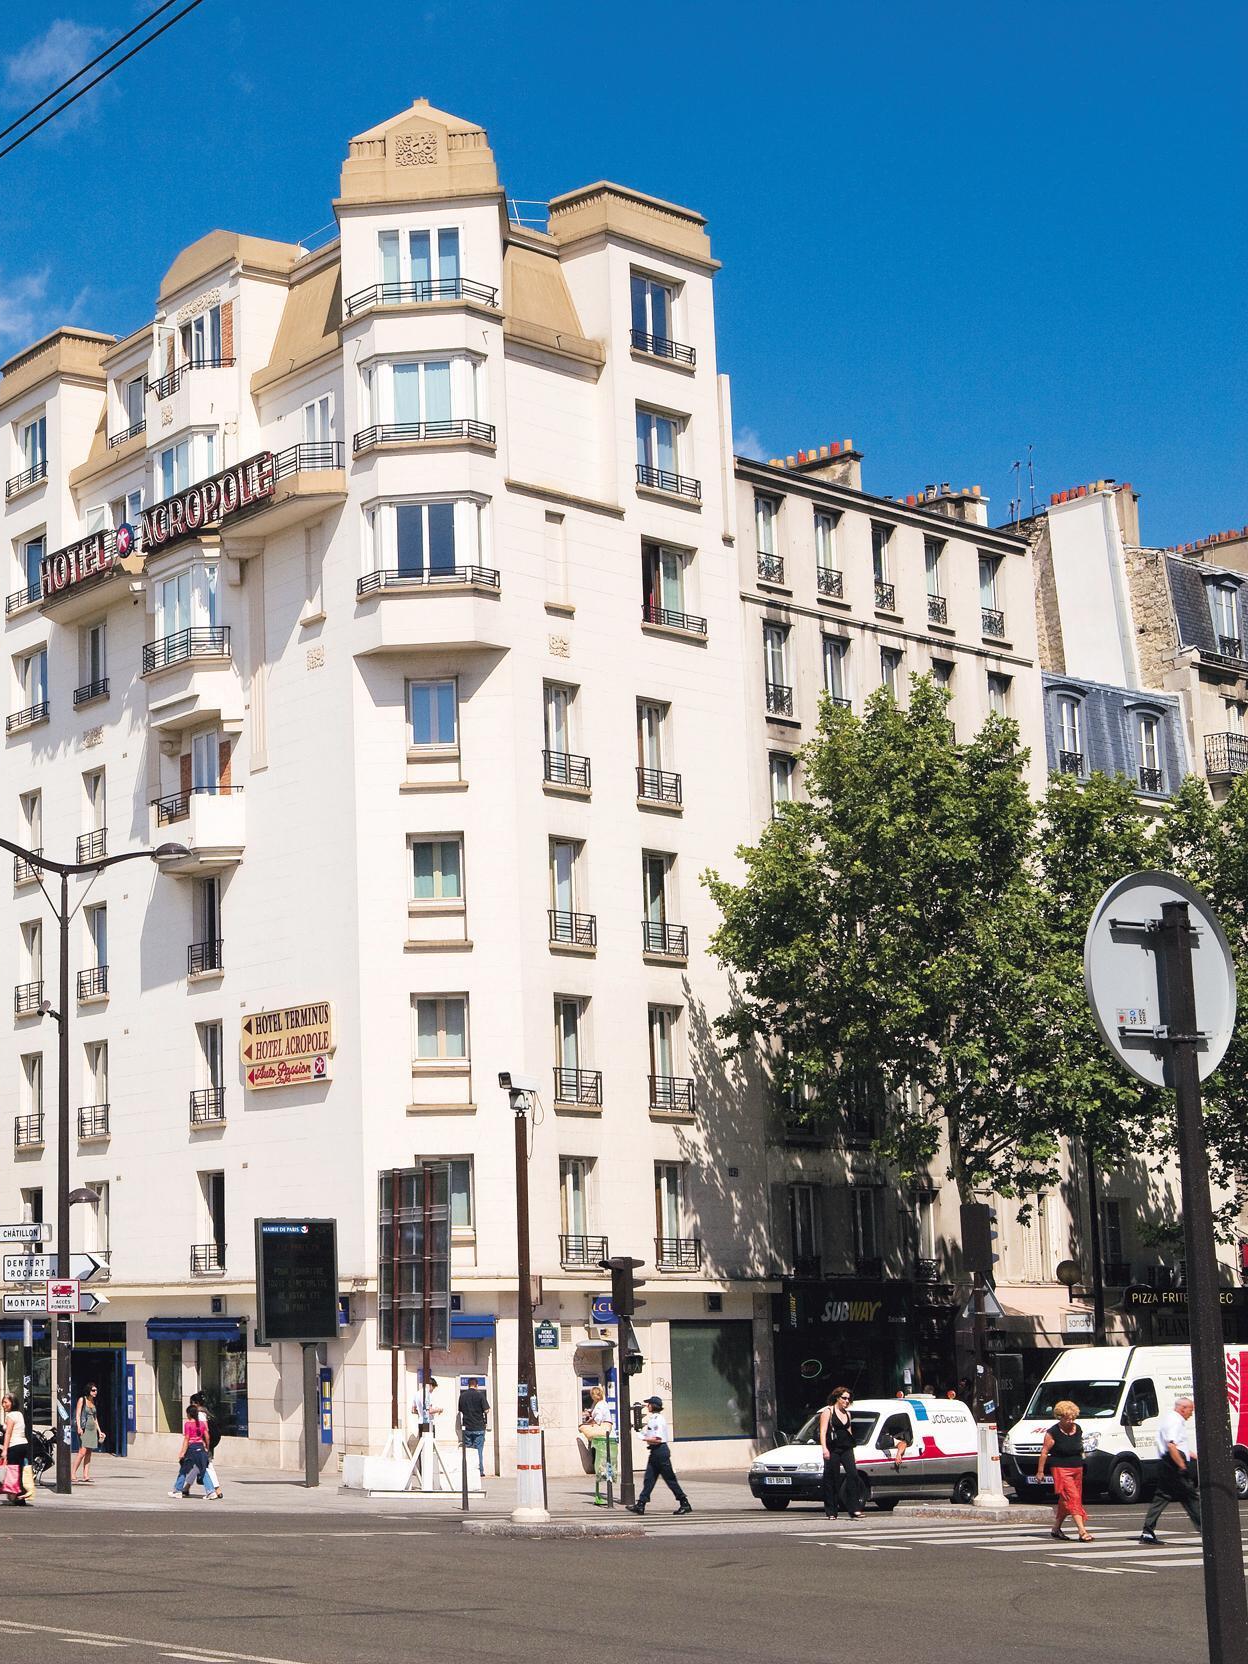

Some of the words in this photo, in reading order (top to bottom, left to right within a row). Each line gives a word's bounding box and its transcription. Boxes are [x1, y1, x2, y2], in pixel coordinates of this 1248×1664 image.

[39, 535, 112, 596] HOTEL
[140, 452, 275, 553] ACROPOLE
[255, 1013, 283, 1035] HOTEL
[285, 1004, 329, 1030] TERMINUS
[255, 1039, 284, 1060] HOTEL
[285, 1031, 329, 1056] ACROPOLE
[278, 1061, 311, 1076] Passion
[6, 1259, 45, 1267] DENFERT
[7, 1299, 46, 1307] MONTPAR
[1132, 1292, 1158, 1303] PIZZA
[789, 1291, 797, 1328] SUBWAY
[821, 1301, 882, 1322] SUBWAY
[1225, 1352, 1240, 1413] AVIS
[931, 1414, 968, 1425] JCDecaux
